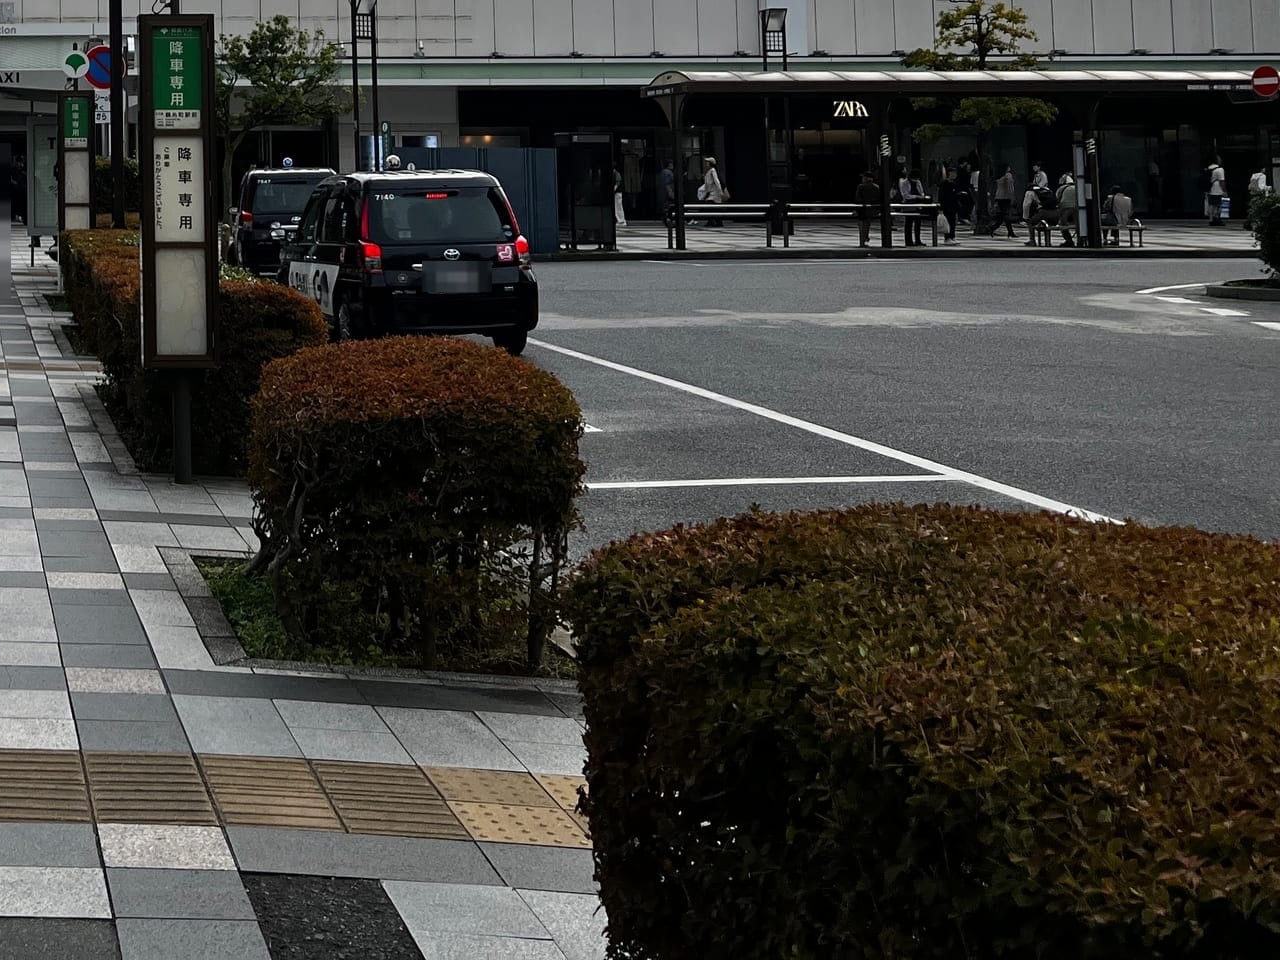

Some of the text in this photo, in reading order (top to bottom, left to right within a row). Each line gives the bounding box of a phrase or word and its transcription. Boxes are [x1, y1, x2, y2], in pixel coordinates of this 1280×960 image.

[169, 41, 184, 107] 降車専用
[833, 101, 870, 117] ZARA
[178, 147, 193, 230] 降車専用
[374, 193, 395, 201] 7140
